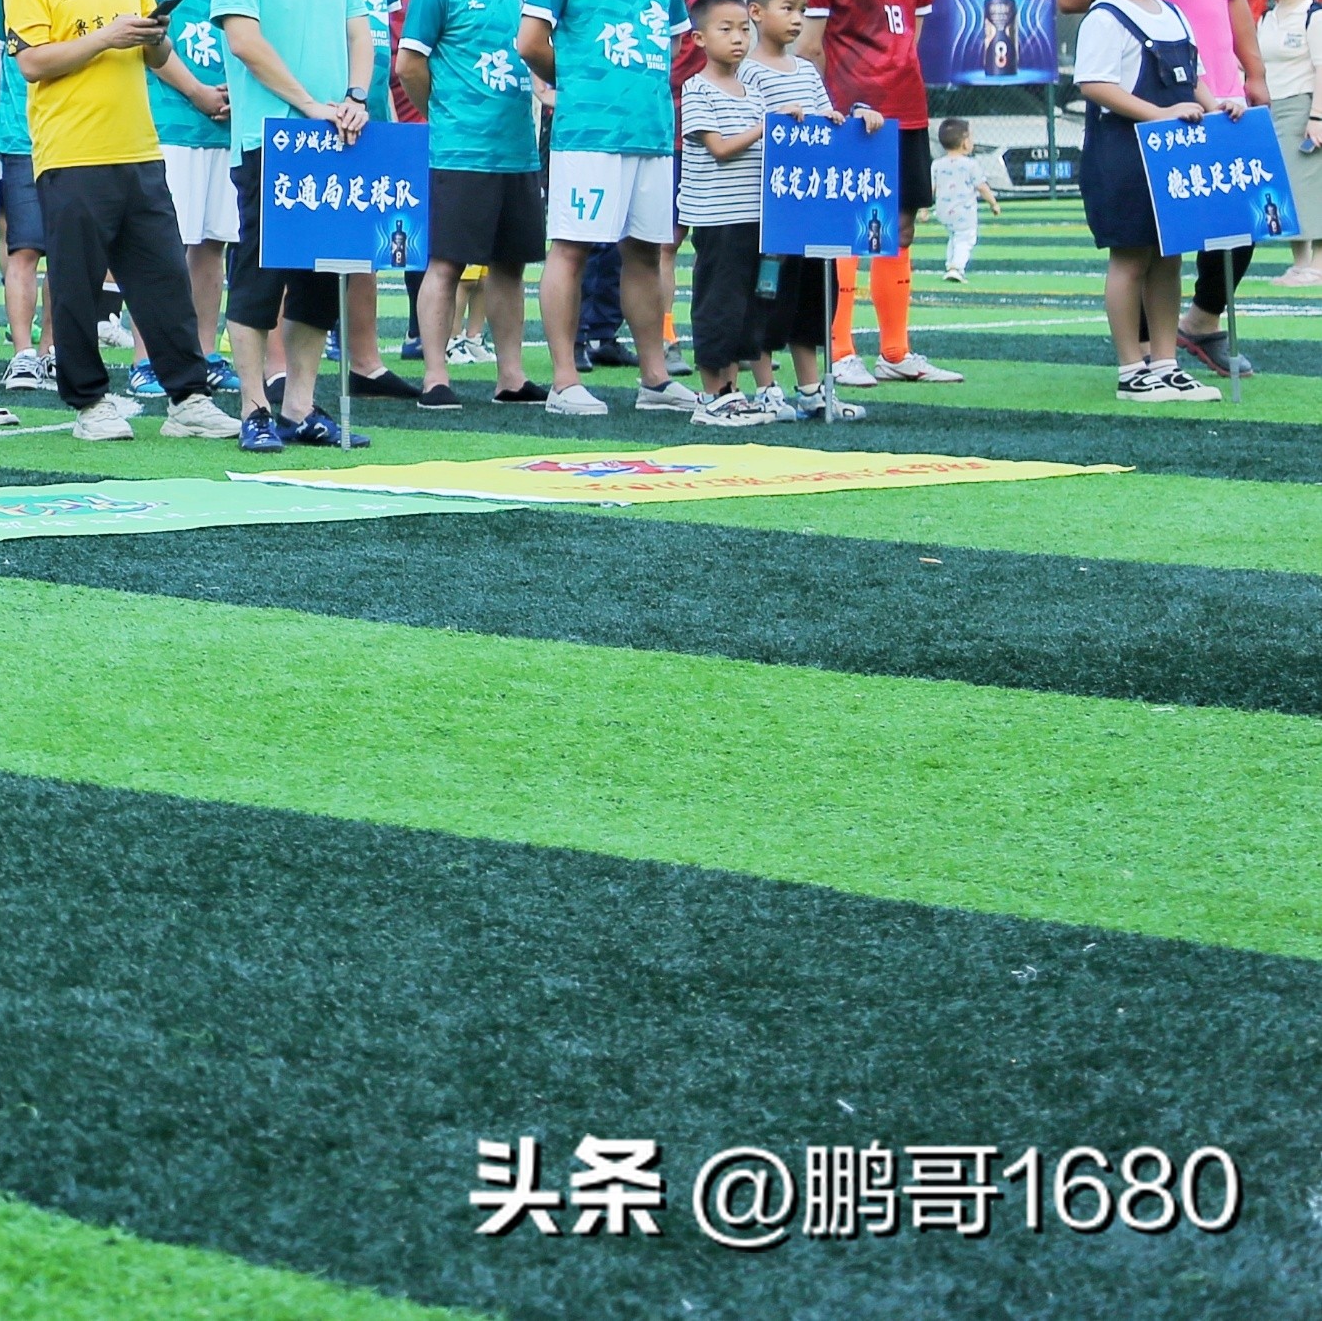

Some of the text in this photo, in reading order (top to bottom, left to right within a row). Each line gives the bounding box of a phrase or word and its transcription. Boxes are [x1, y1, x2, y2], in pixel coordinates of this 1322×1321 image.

[884, 4, 904, 35] 18
[177, 20, 221, 67] 保
[473, 49, 518, 92] 保
[273, 172, 420, 213] 交通局足球队
[770, 165, 892, 203] 保定力量足球队
[1167, 157, 1274, 200] 德奥足球队
[570, 187, 605, 220] 47
